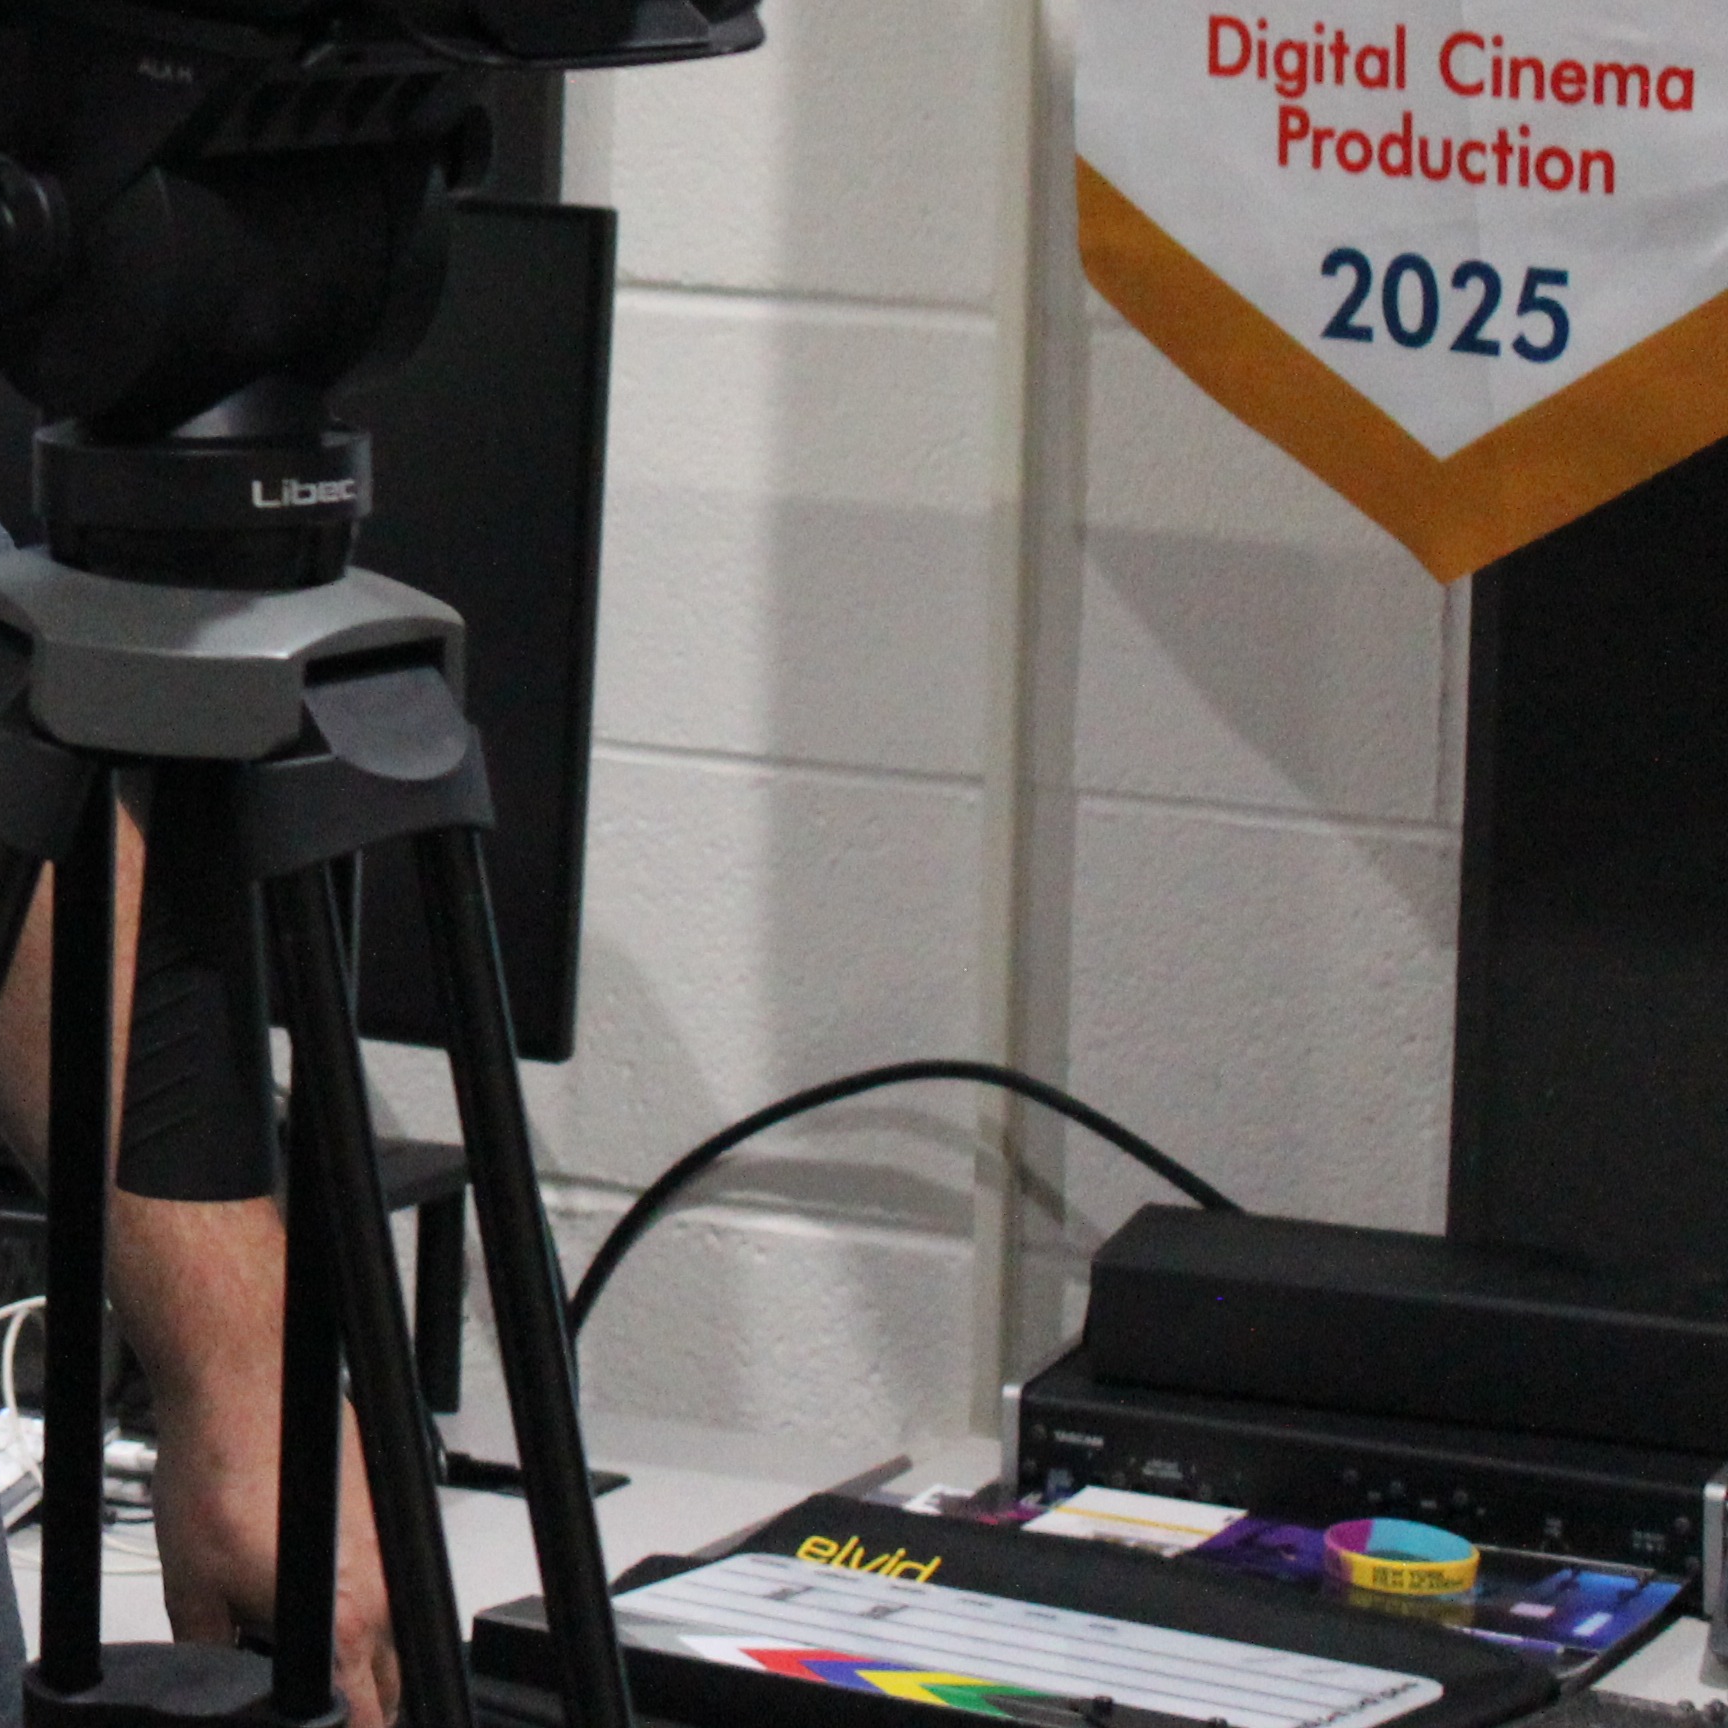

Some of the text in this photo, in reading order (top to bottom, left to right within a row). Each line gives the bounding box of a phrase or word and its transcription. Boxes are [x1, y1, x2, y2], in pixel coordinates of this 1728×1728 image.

[1208, 14, 1695, 112] Digital Cinema
[1277, 105, 1616, 195] Production
[1319, 246, 1571, 364] 2025
[251, 478, 356, 509] Libec
[795, 1535, 943, 1584] elvid
